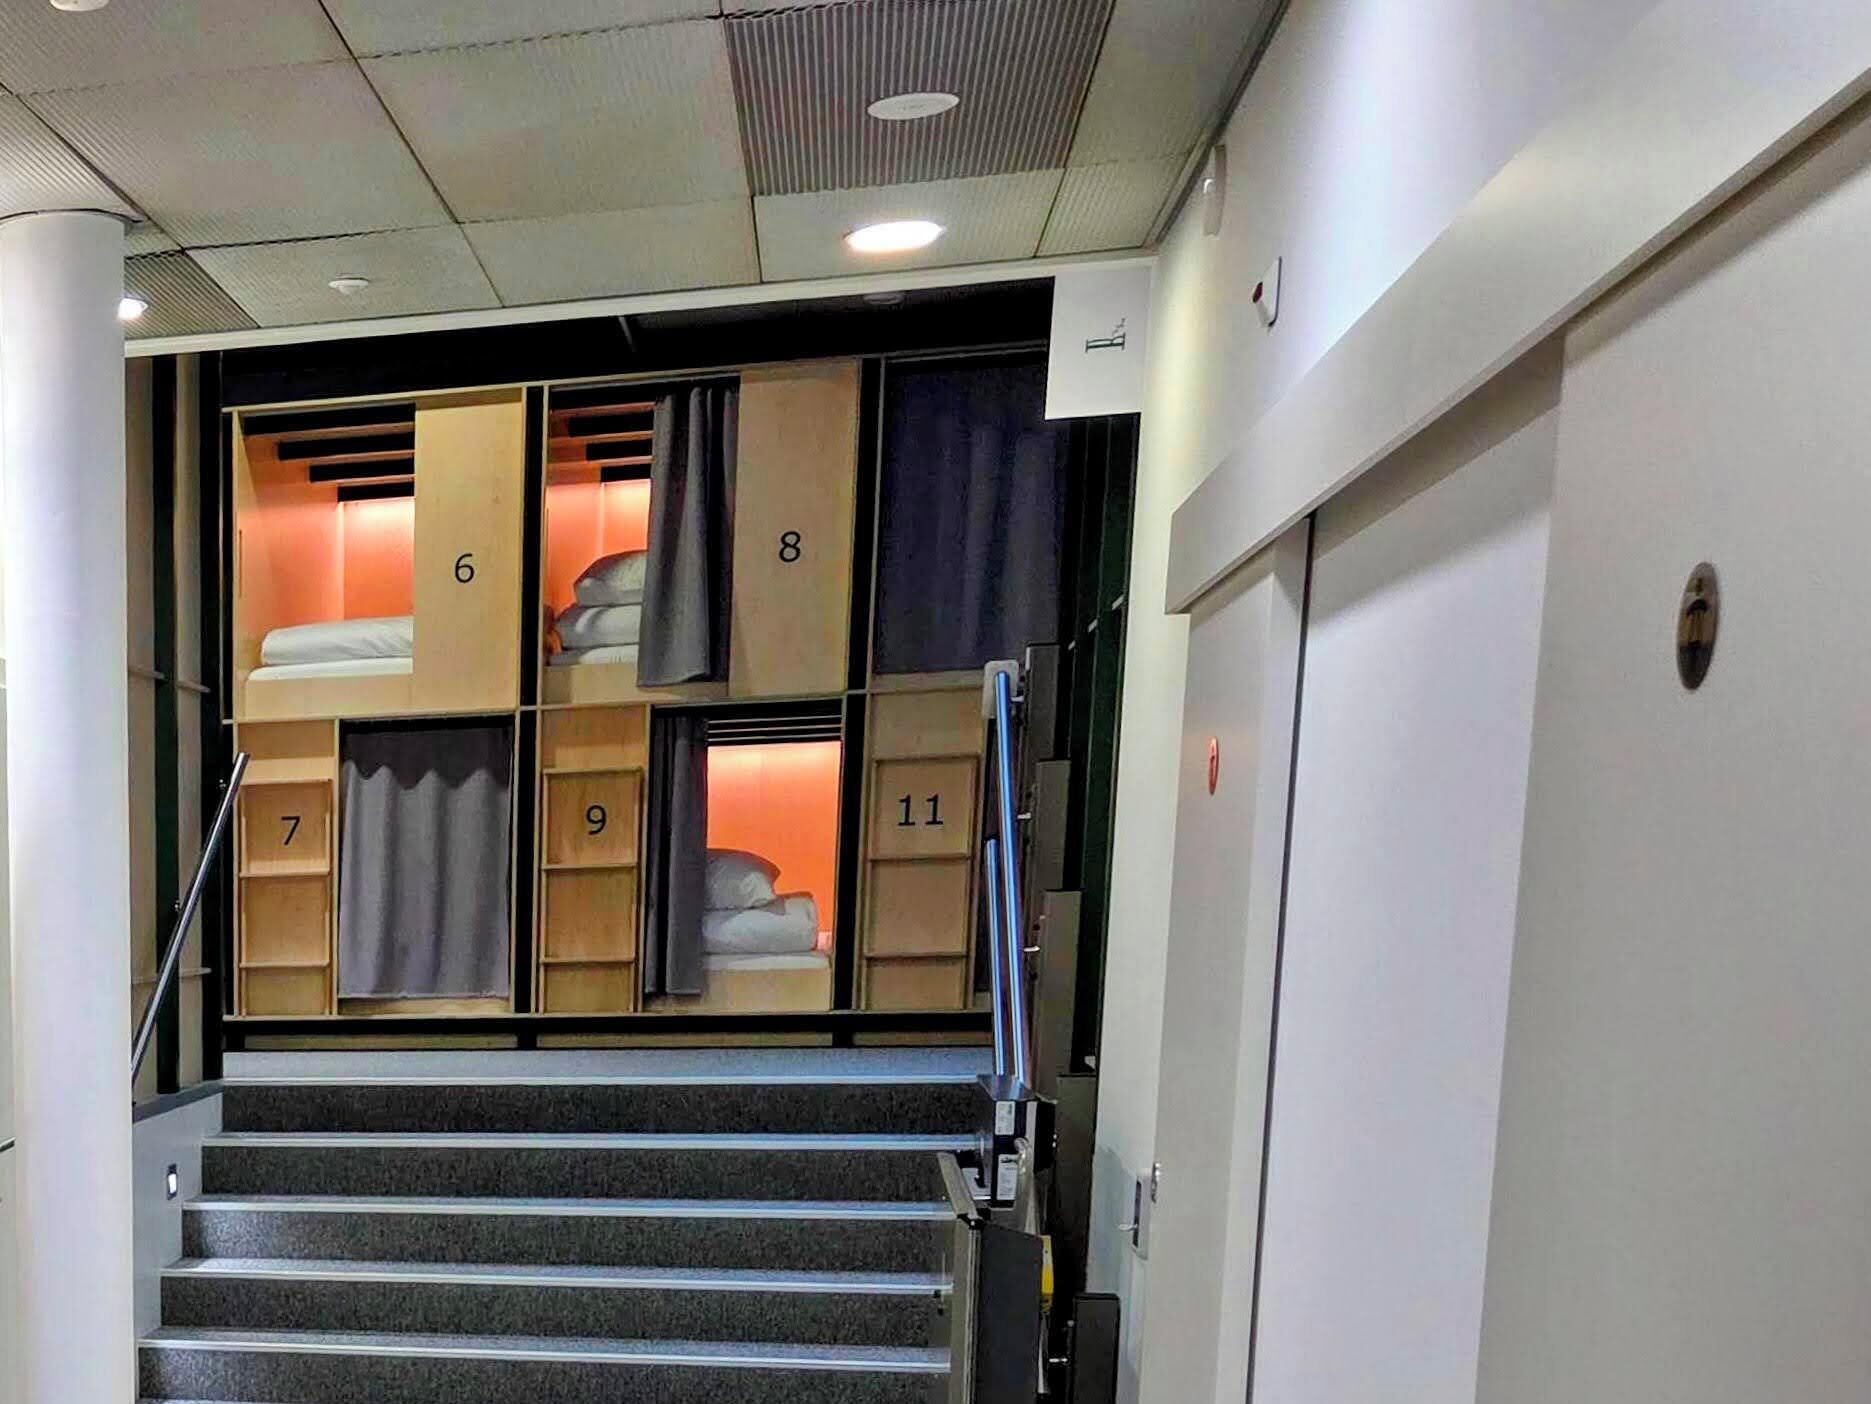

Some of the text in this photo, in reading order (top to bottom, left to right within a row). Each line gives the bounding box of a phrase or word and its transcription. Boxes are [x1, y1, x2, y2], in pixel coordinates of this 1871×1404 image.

[778, 531, 801, 563] 8
[454, 553, 475, 584] 6
[585, 804, 607, 836] 9
[897, 793, 944, 827] 11
[281, 815, 301, 846] 7
